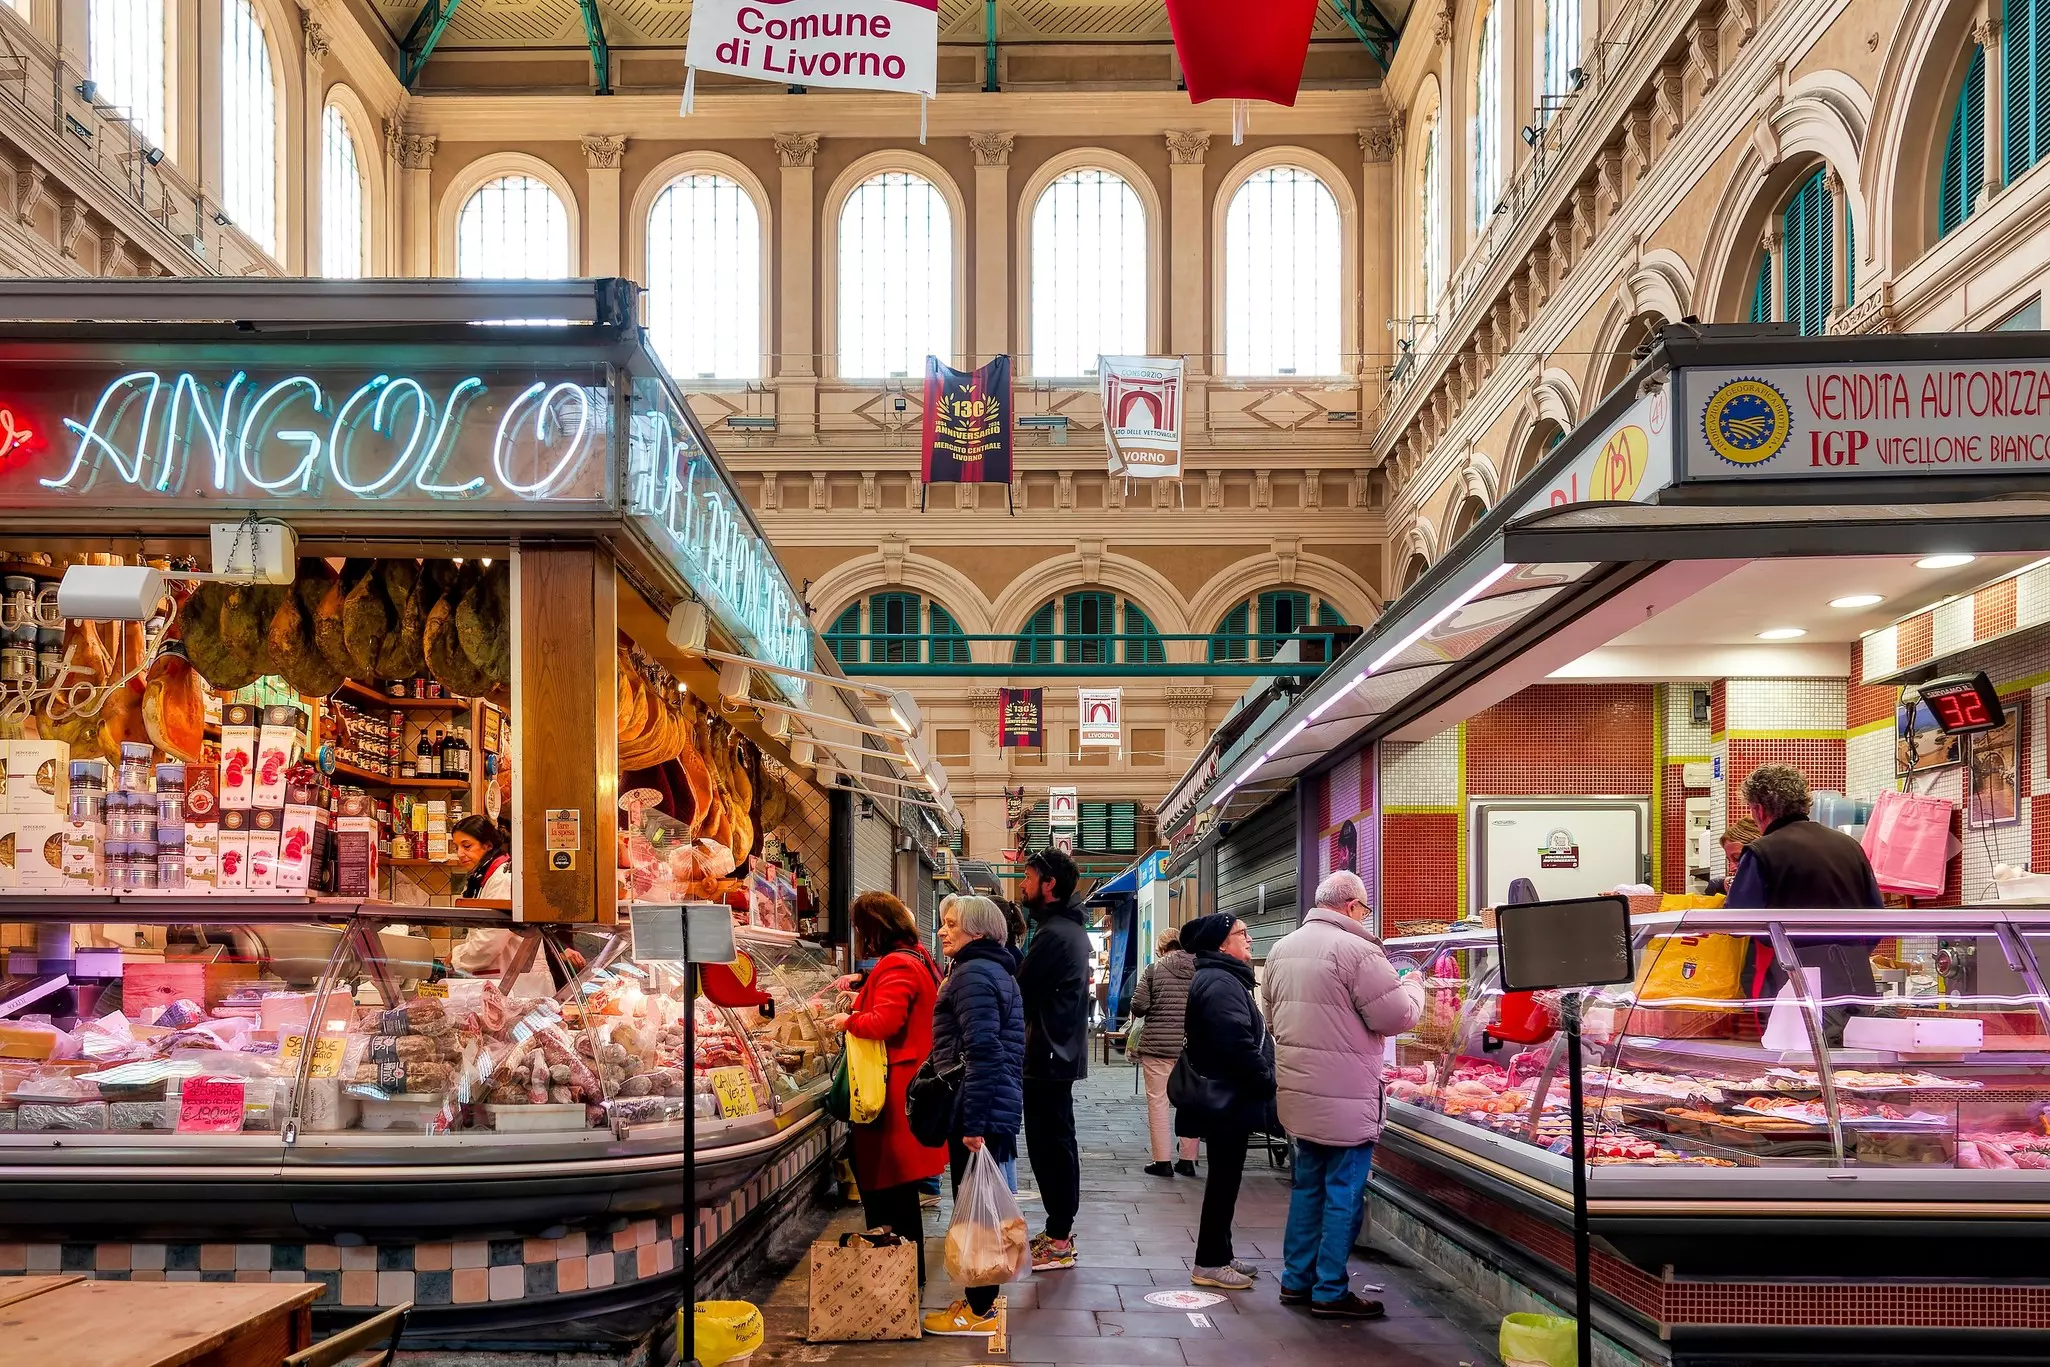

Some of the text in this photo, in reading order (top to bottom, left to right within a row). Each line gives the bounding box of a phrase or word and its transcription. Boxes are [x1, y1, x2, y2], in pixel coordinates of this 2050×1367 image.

[737, 7, 892, 41] Comune
[716, 38, 907, 79] di Livorno
[1122, 369, 1163, 379] CONSORZIO
[1807, 374, 1909, 420] VENDITA
[39, 370, 588, 492] ANGOLO
[935, 425, 1001, 440] ANNIVERSARIO
[1709, 384, 1786, 449] INDICAZIONE GEOGRAFICA PROTETTA
[934, 441, 1002, 454] MERCATO CENTRALE
[1143, 429, 1177, 439] VETTOVAGLIE
[1809, 431, 1869, 467] IGP
[1876, 436, 1982, 464] VITELLONE
[952, 452, 983, 462] LIVORNO
[1122, 451, 1166, 464] VORNO
[1940, 691, 1986, 727] 32
